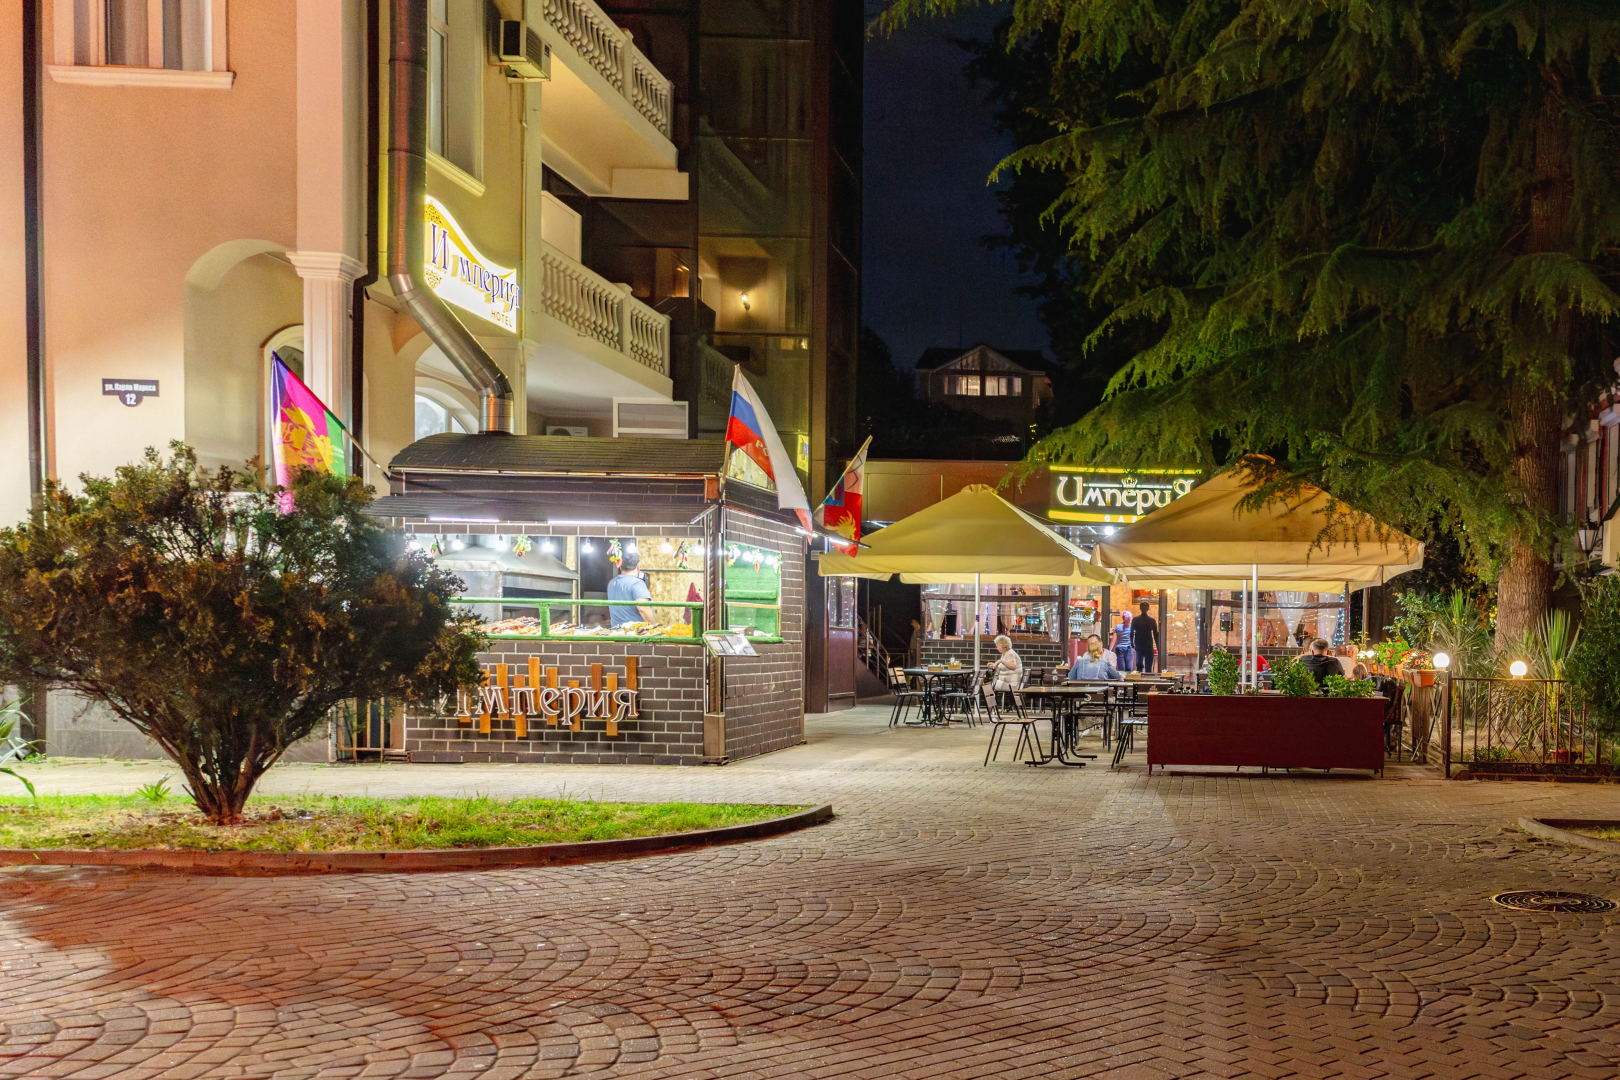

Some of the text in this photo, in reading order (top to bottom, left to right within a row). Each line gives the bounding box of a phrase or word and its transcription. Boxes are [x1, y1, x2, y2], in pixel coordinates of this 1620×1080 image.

[491, 308, 513, 328] HOTEL
[125, 393, 137, 405] 12
[1104, 514, 1138, 524] CAF
